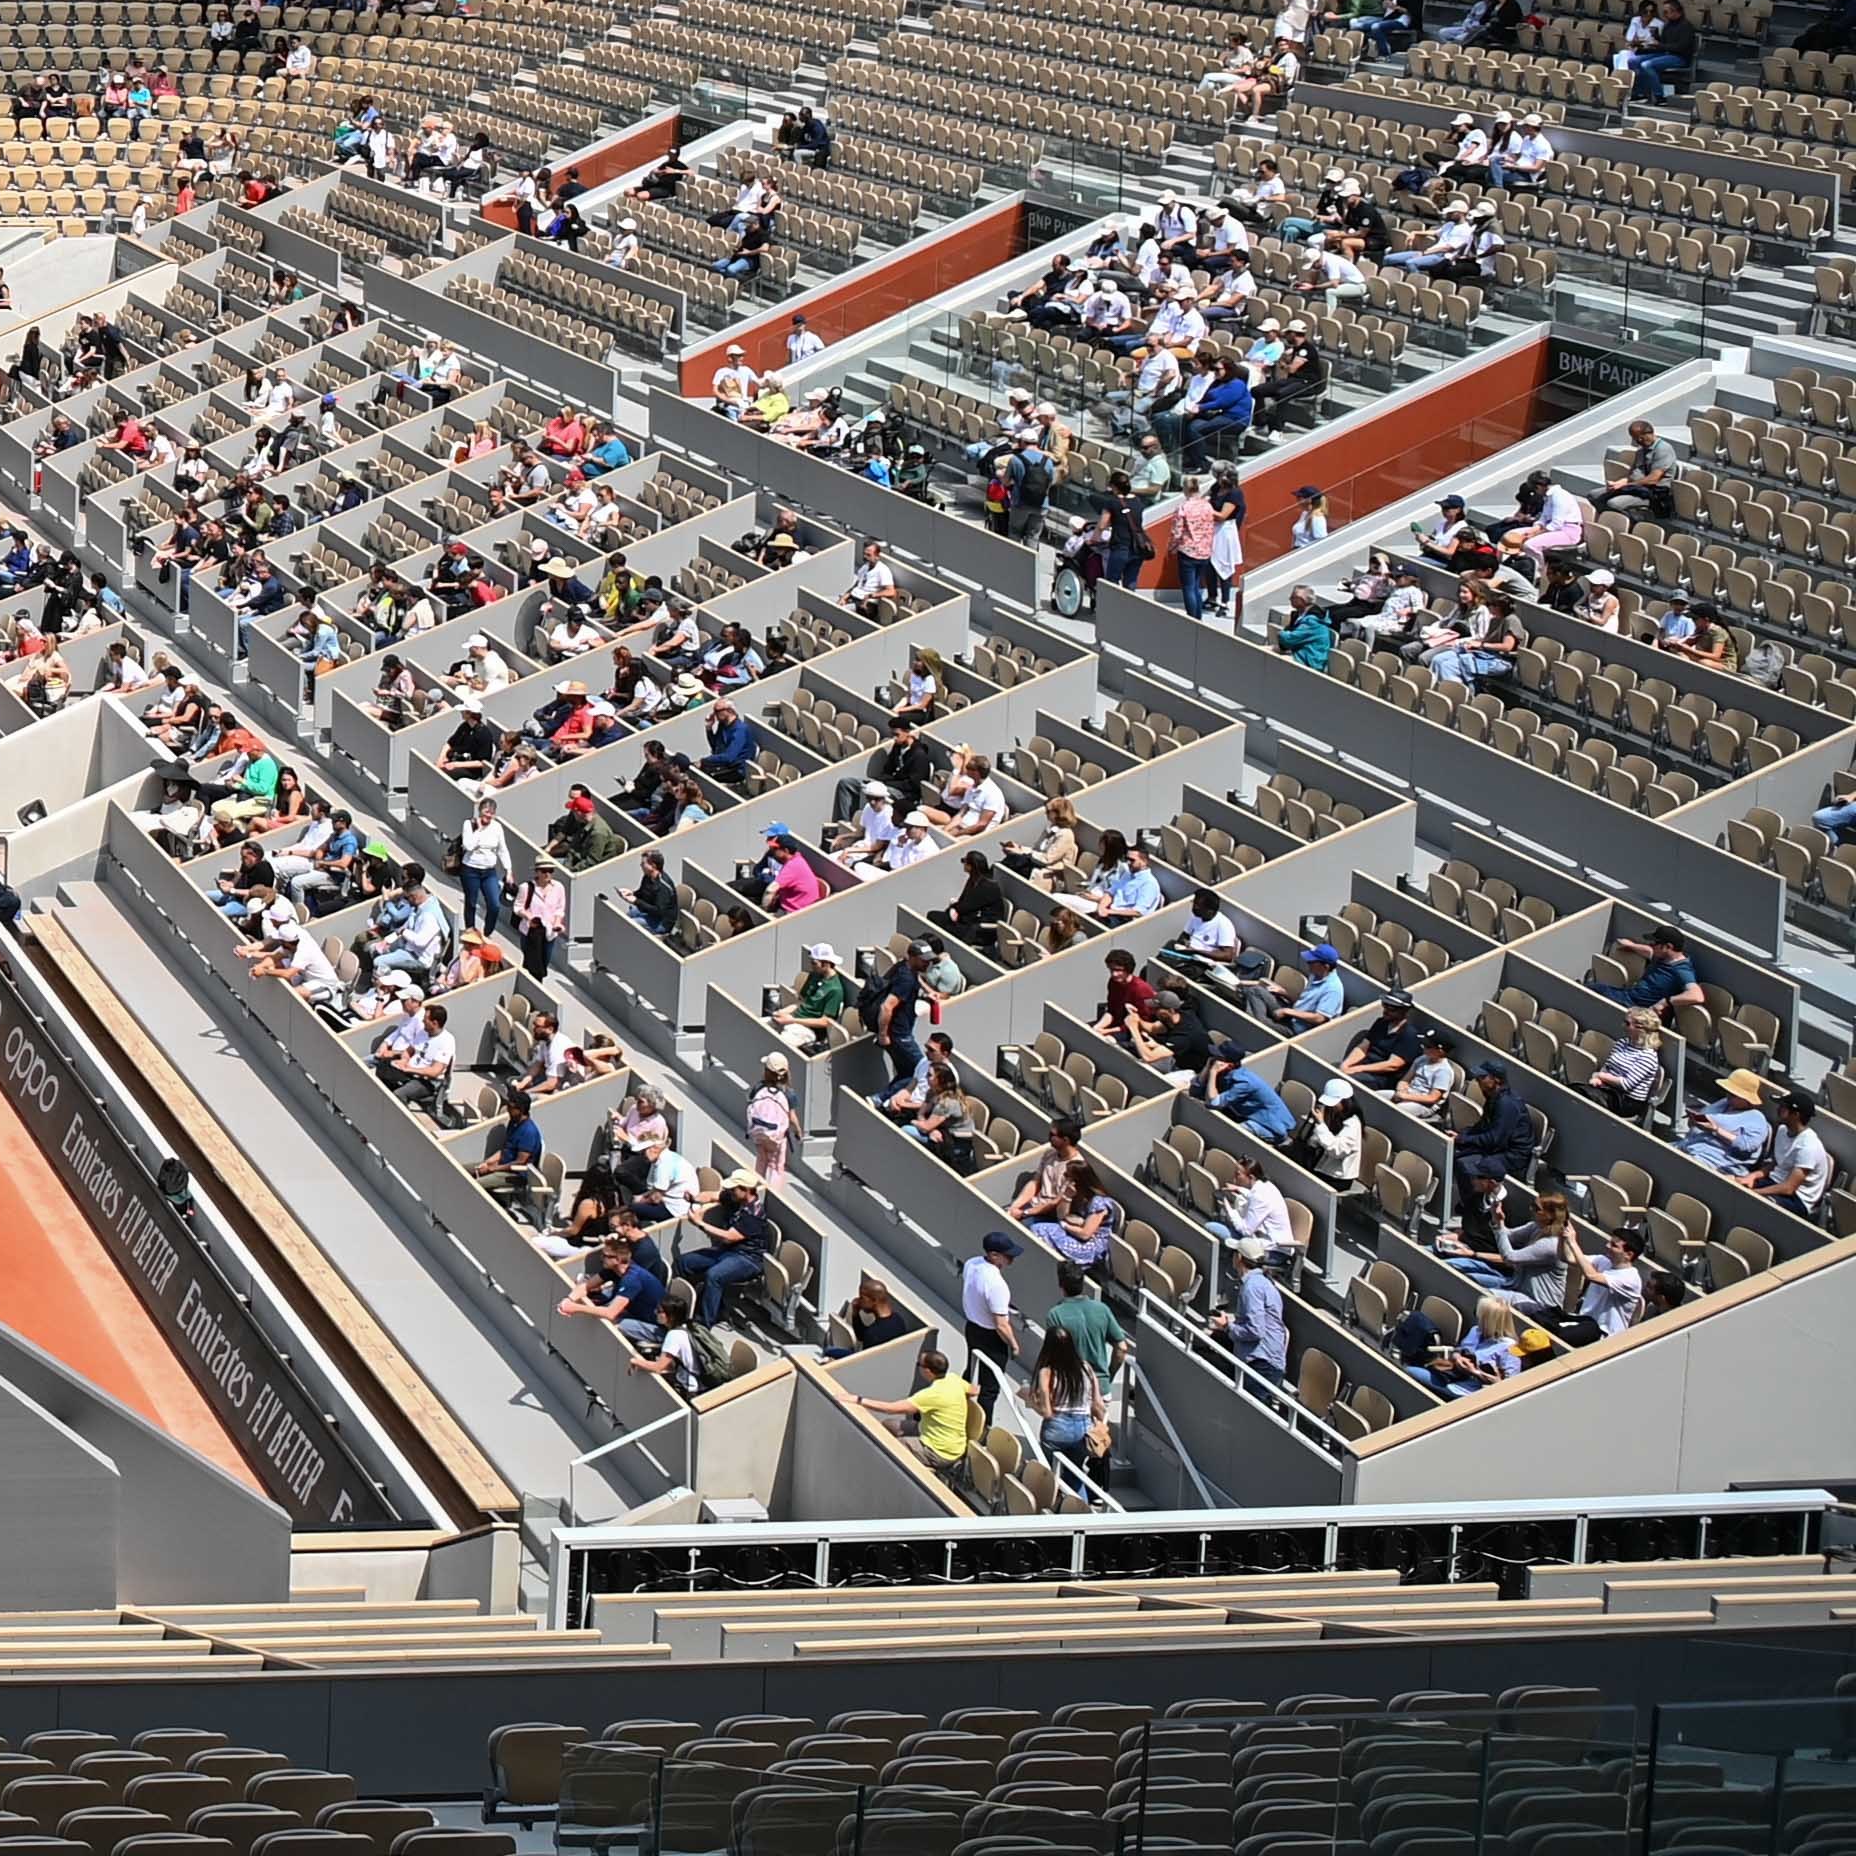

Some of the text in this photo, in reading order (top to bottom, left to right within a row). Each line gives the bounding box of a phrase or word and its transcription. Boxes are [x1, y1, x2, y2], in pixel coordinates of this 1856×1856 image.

[1559, 351, 1594, 377] BNP
[5, 1025, 59, 1112] oppo
[61, 1112, 178, 1296] Emirates FLY BETTER
[176, 1279, 254, 1407] Emirates
[266, 1411, 326, 1507] BETTER
